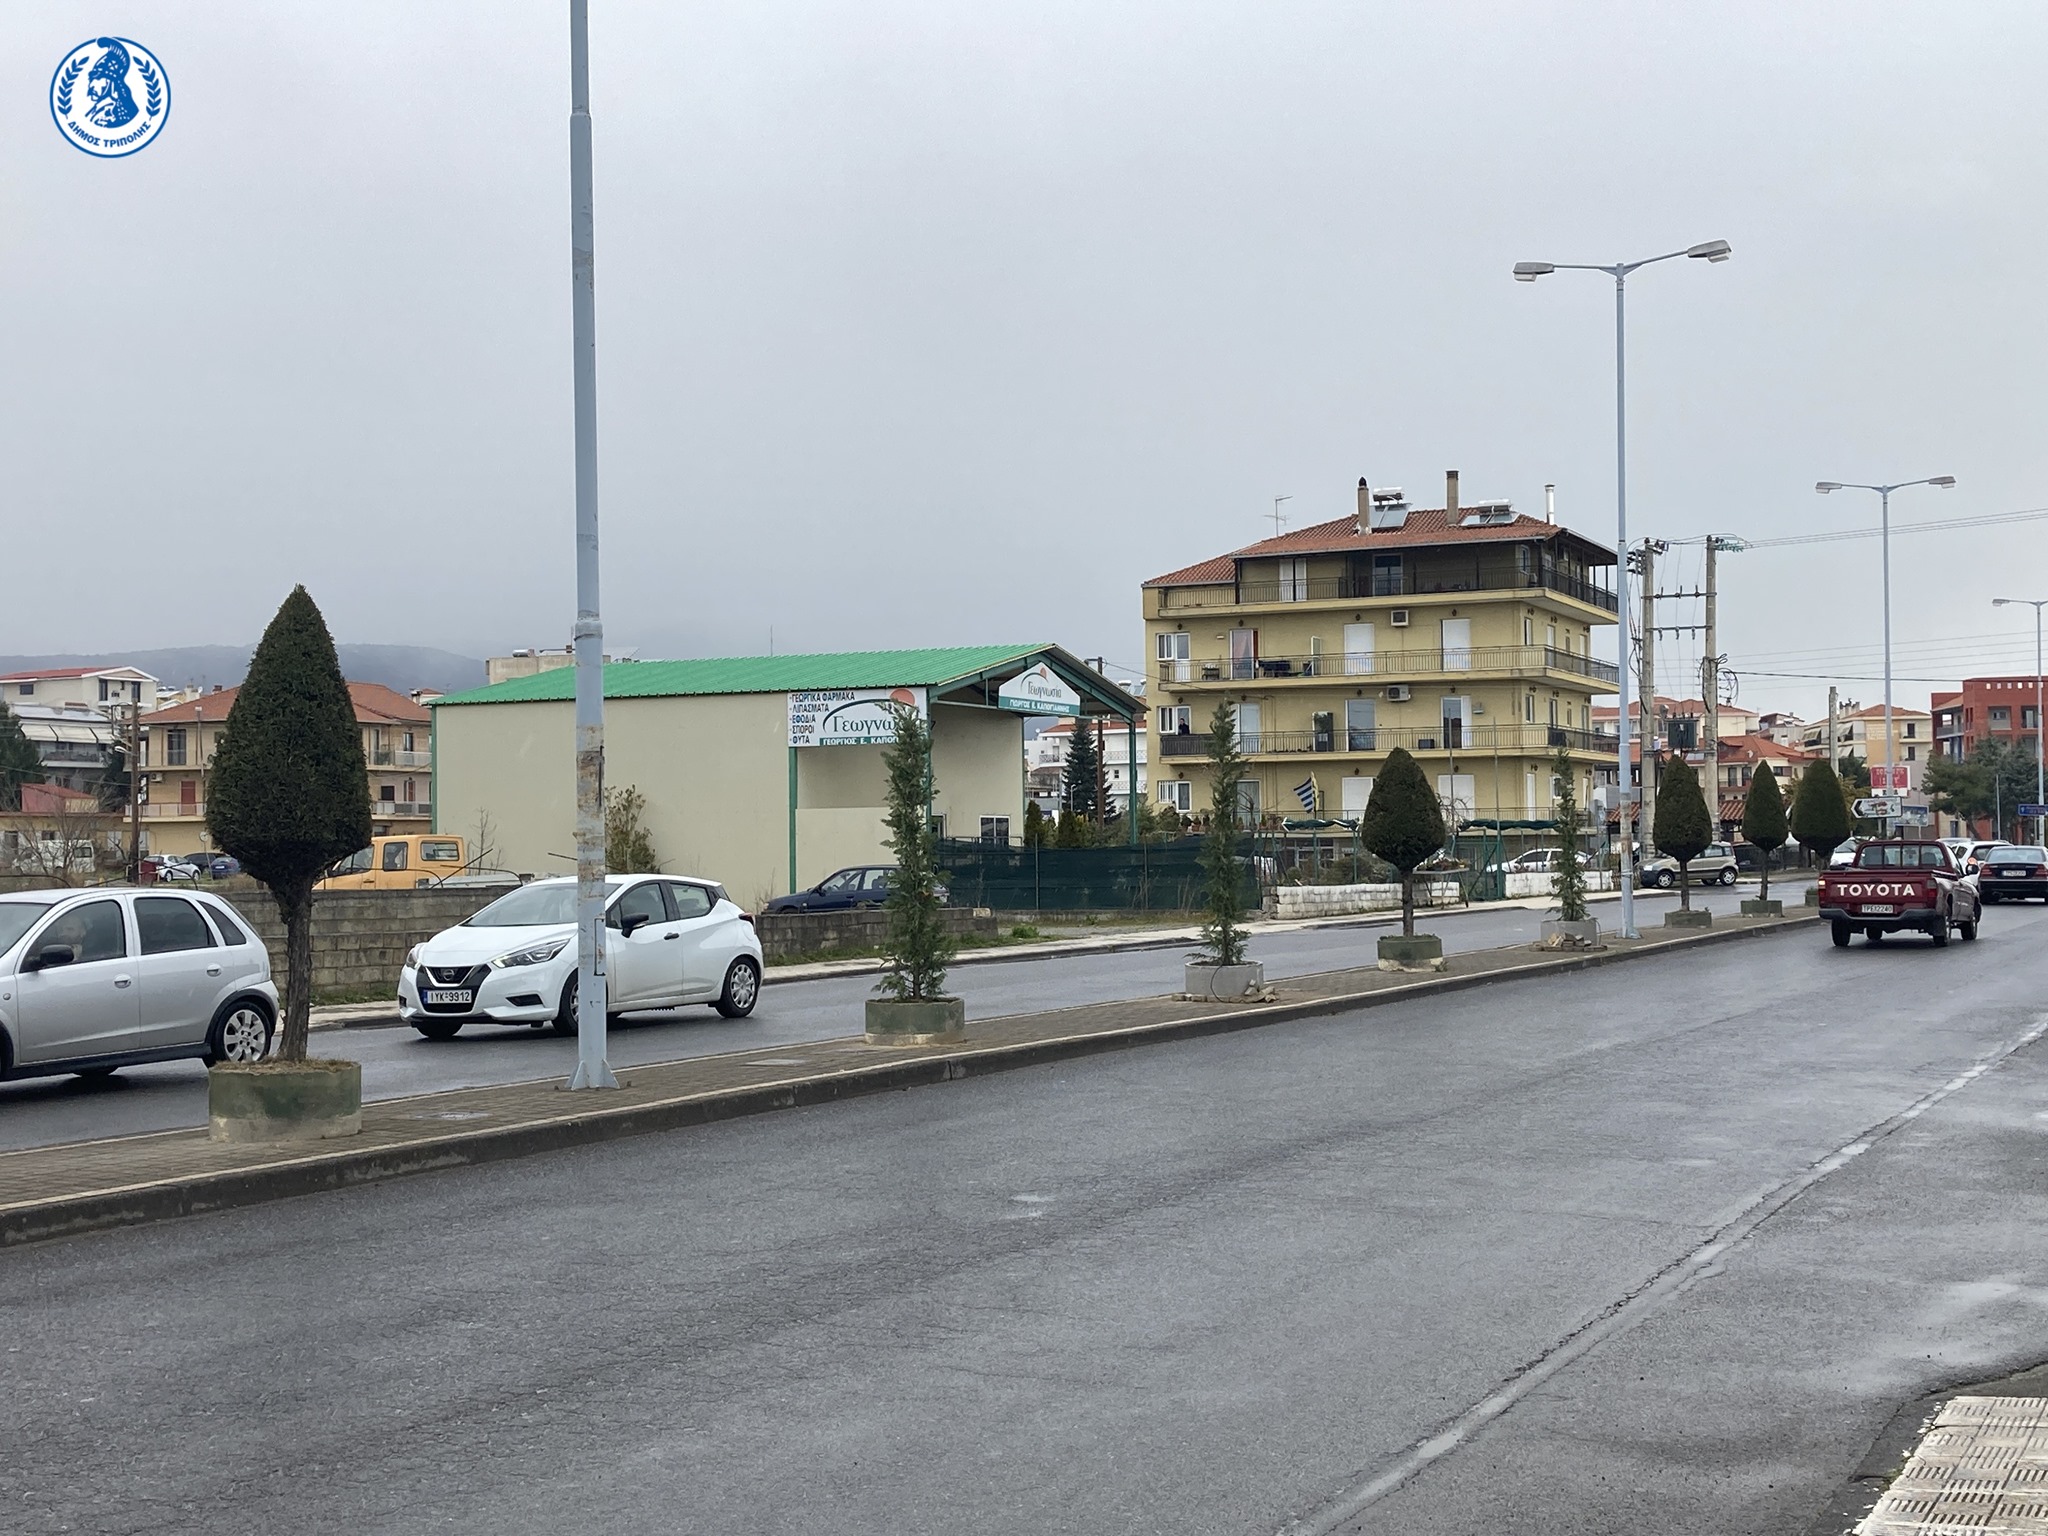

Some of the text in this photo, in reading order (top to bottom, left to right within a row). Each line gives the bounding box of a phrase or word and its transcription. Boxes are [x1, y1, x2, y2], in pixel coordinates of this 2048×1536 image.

[792, 692, 855, 703] ΓΕΩΡΓΙΚΑ ΦΑΡΜΑΚΑ
[792, 703, 829, 713] ΛΙΠΑΣΜΑΤΑ
[792, 714, 816, 724] ΕΦΟΔΙΑ
[792, 725, 815, 734] ΣΠΟΡΟΙ
[833, 716, 896, 735] Γεωγνω
[792, 735, 810, 744] ΦΥΤΑ
[823, 738, 857, 746] ΓΕΩΡΓΙΟΣ
[1837, 884, 1915, 896] TOYOTA
